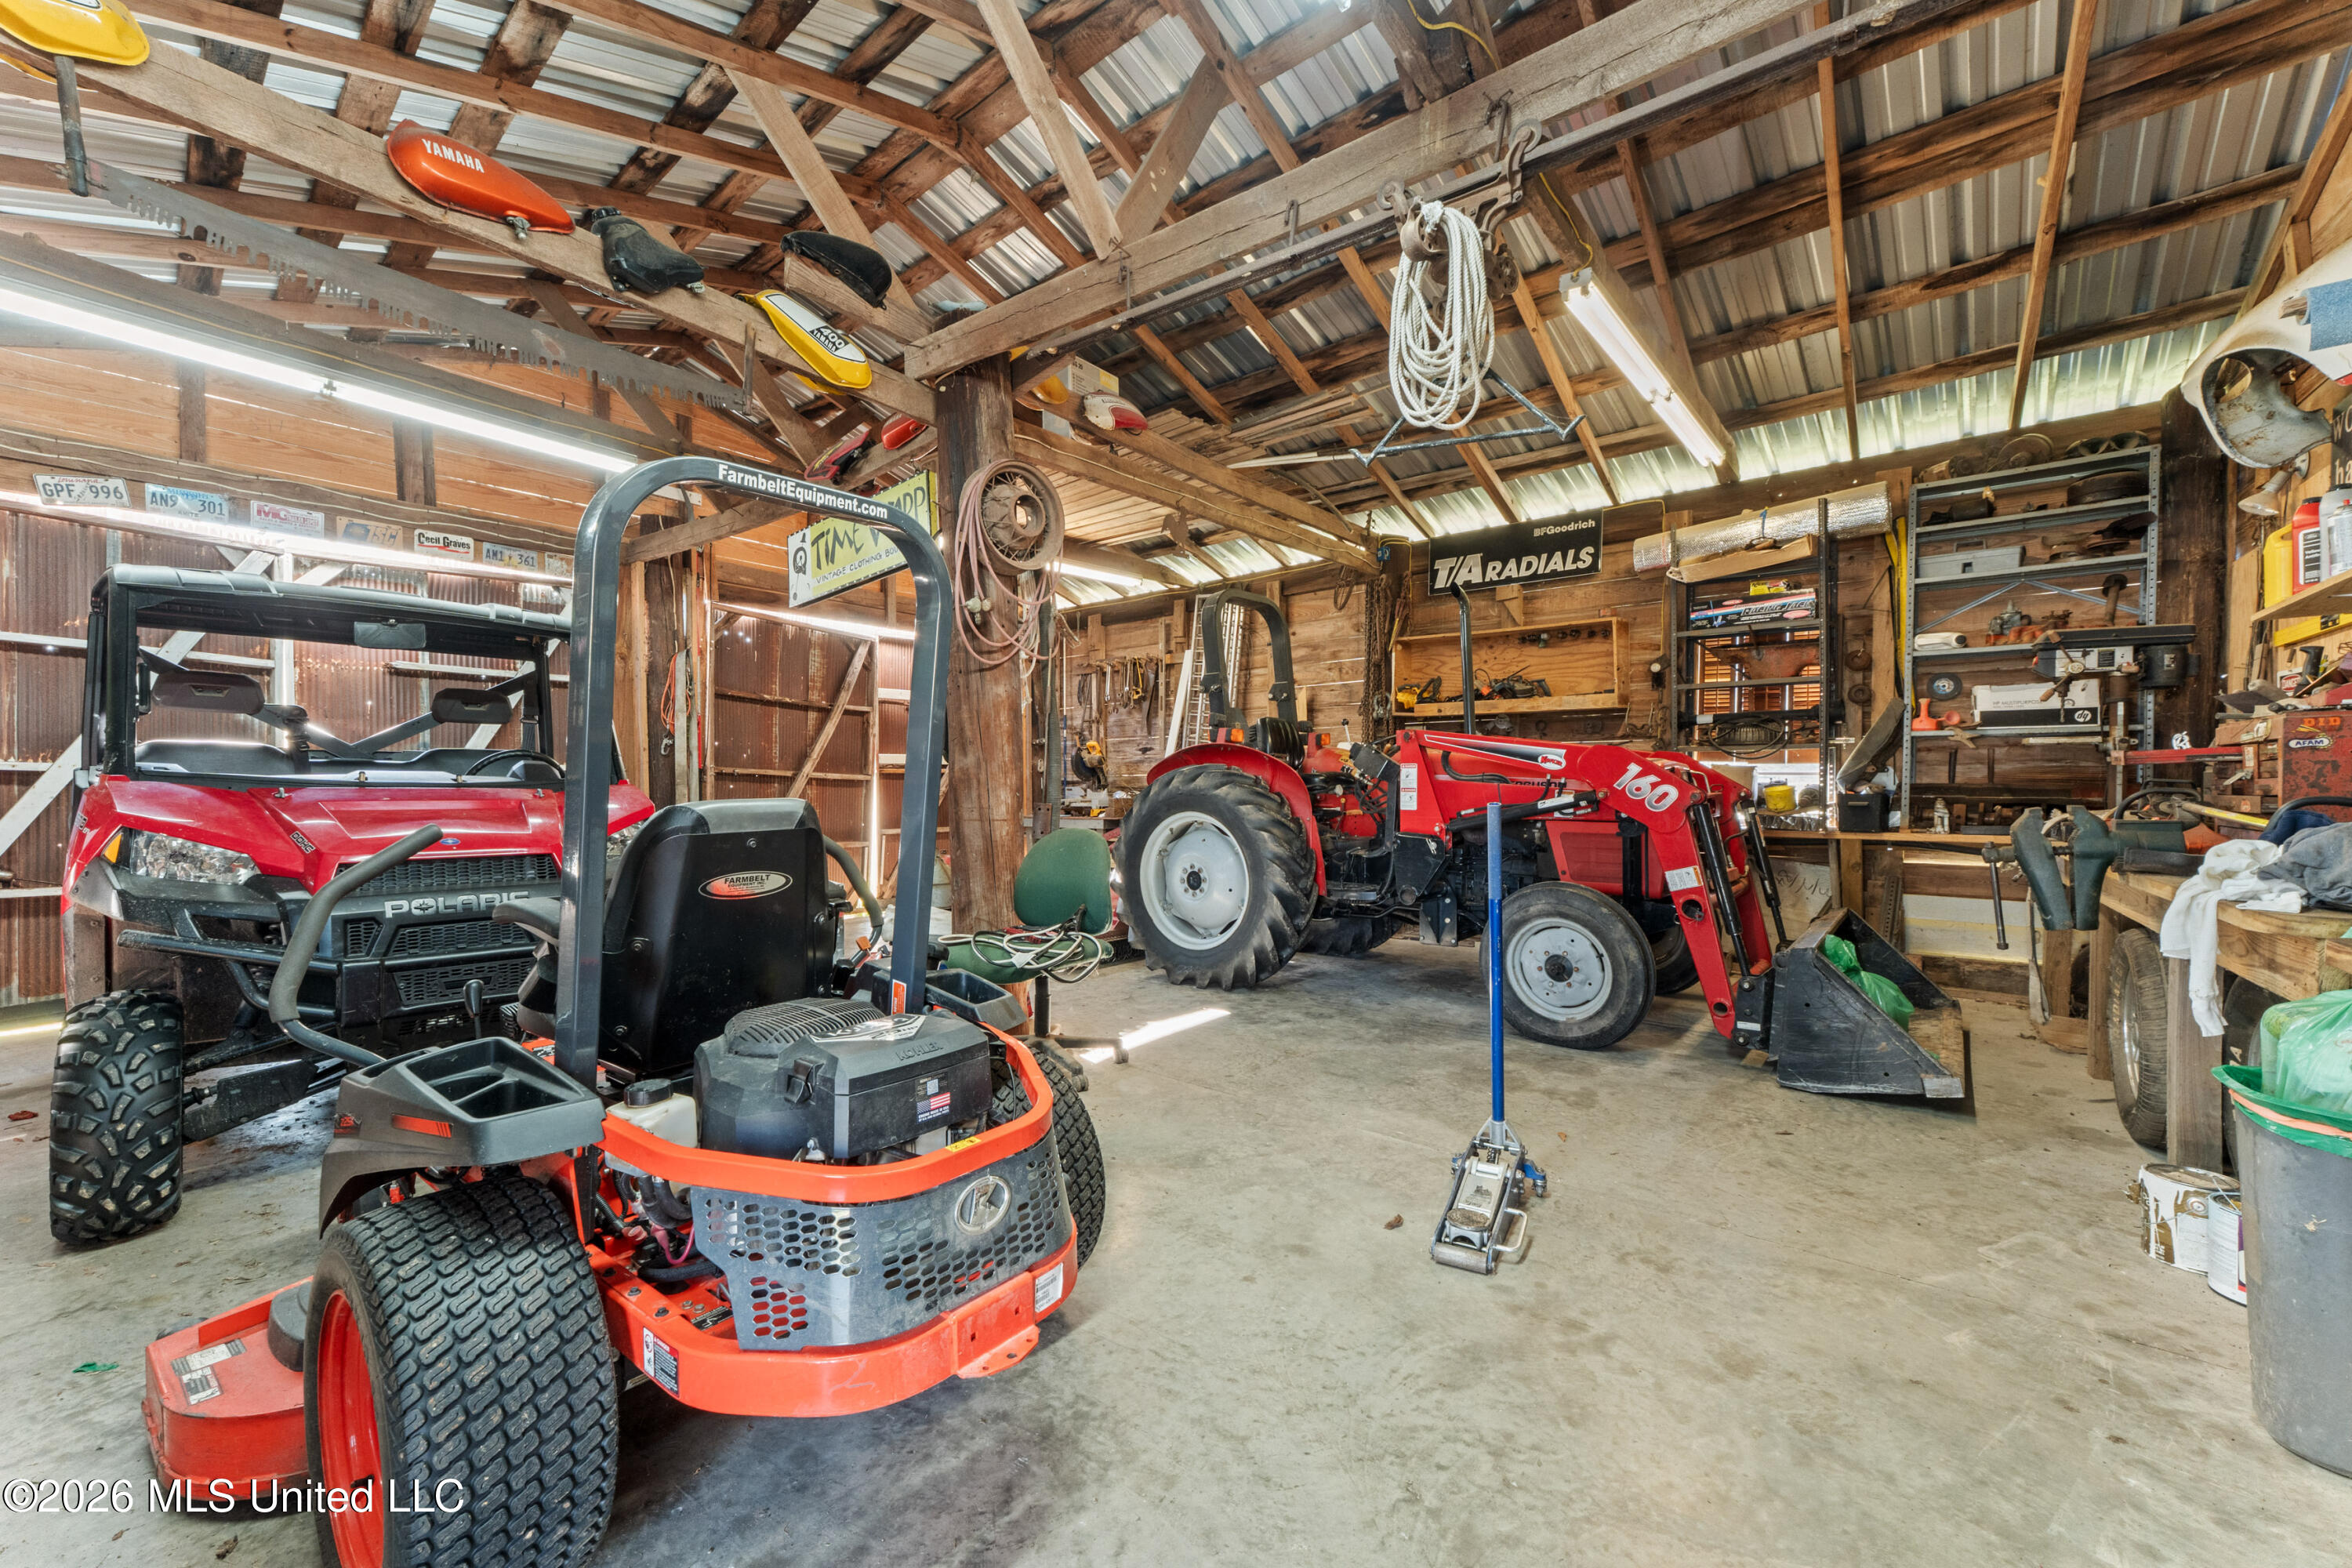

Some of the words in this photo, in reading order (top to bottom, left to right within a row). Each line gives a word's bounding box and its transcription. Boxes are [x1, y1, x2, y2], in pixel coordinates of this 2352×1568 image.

[421, 138, 485, 173] YAMAHA
[813, 329, 837, 353] YAMAHA
[819, 328, 845, 348] 400
[42, 482, 74, 498] GPF
[88, 484, 123, 499] 996
[718, 463, 888, 519] FarmbeltEquipment.com
[150, 492, 179, 508] AN9
[198, 499, 225, 517] 301
[1534, 519, 1595, 537] BFGoodrich
[417, 532, 441, 545] Cecil
[442, 535, 470, 550] Graves
[485, 548, 504, 562] AM1
[517, 554, 535, 567] 361
[816, 566, 847, 585] VINTAGE
[849, 551, 883, 572] CLOTHING
[1433, 552, 1483, 589] T/A
[1484, 546, 1595, 583] RADIALS
[1613, 762, 1679, 812] 160
[290, 831, 316, 854] DOHC
[724, 874, 771, 884] FARMBELT
[895, 1040, 944, 1062] KOHLER
